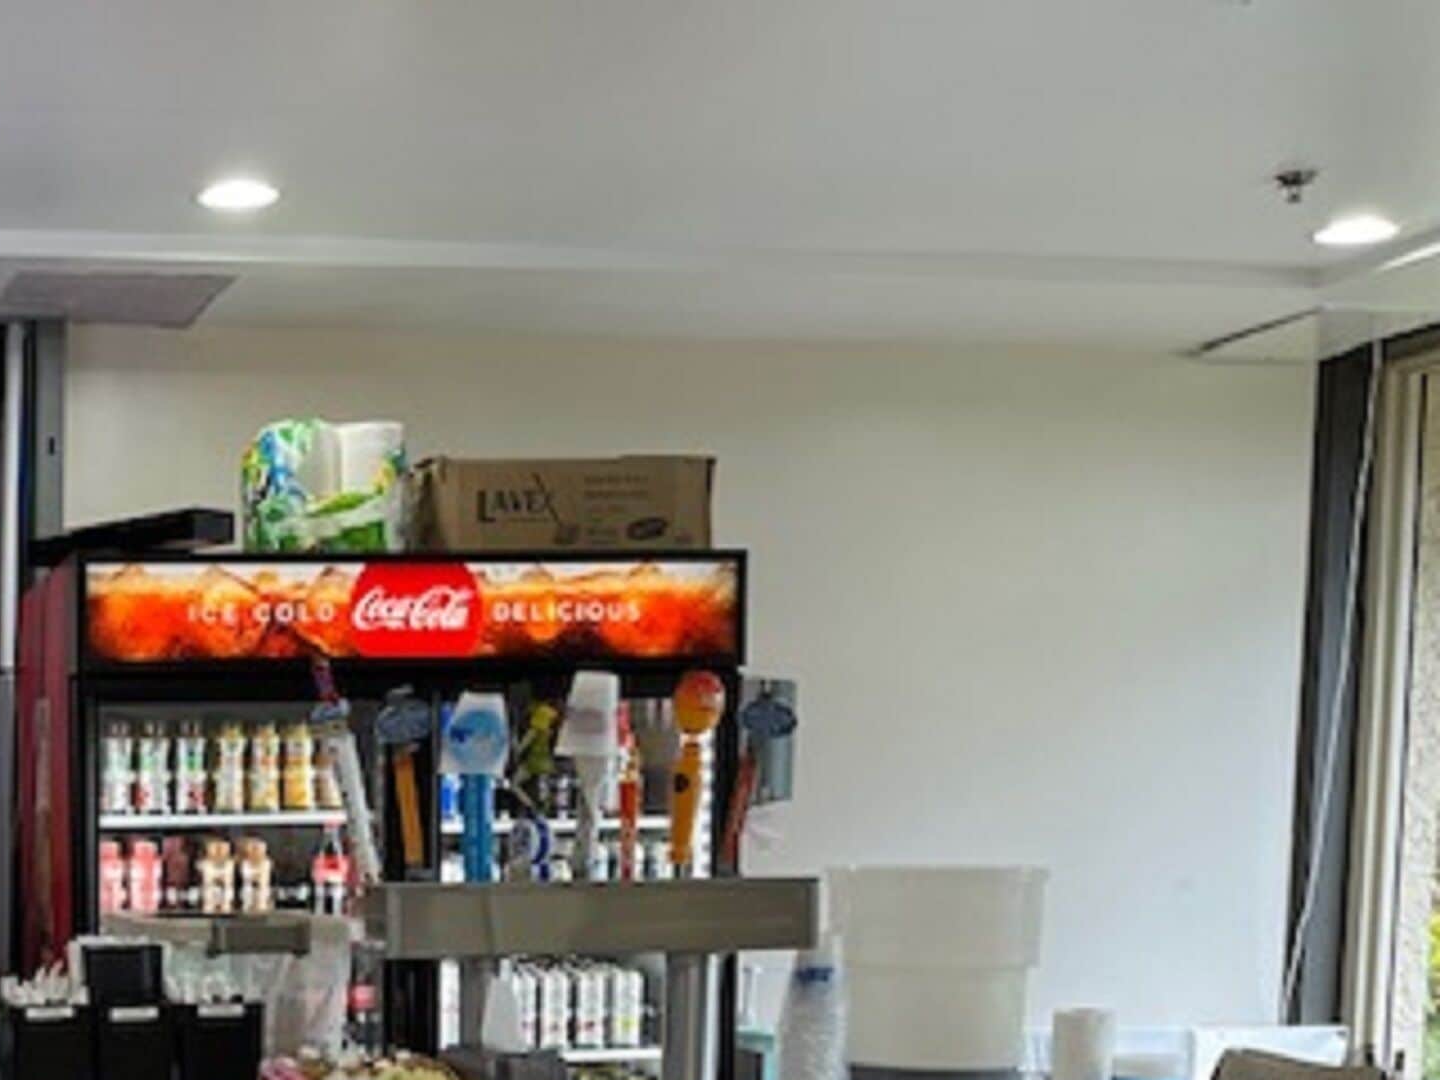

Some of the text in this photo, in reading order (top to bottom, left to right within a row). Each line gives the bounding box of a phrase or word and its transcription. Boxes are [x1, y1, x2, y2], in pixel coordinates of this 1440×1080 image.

[188, 585, 641, 630] ICE COLD Coca-Cola DELICIOUS
